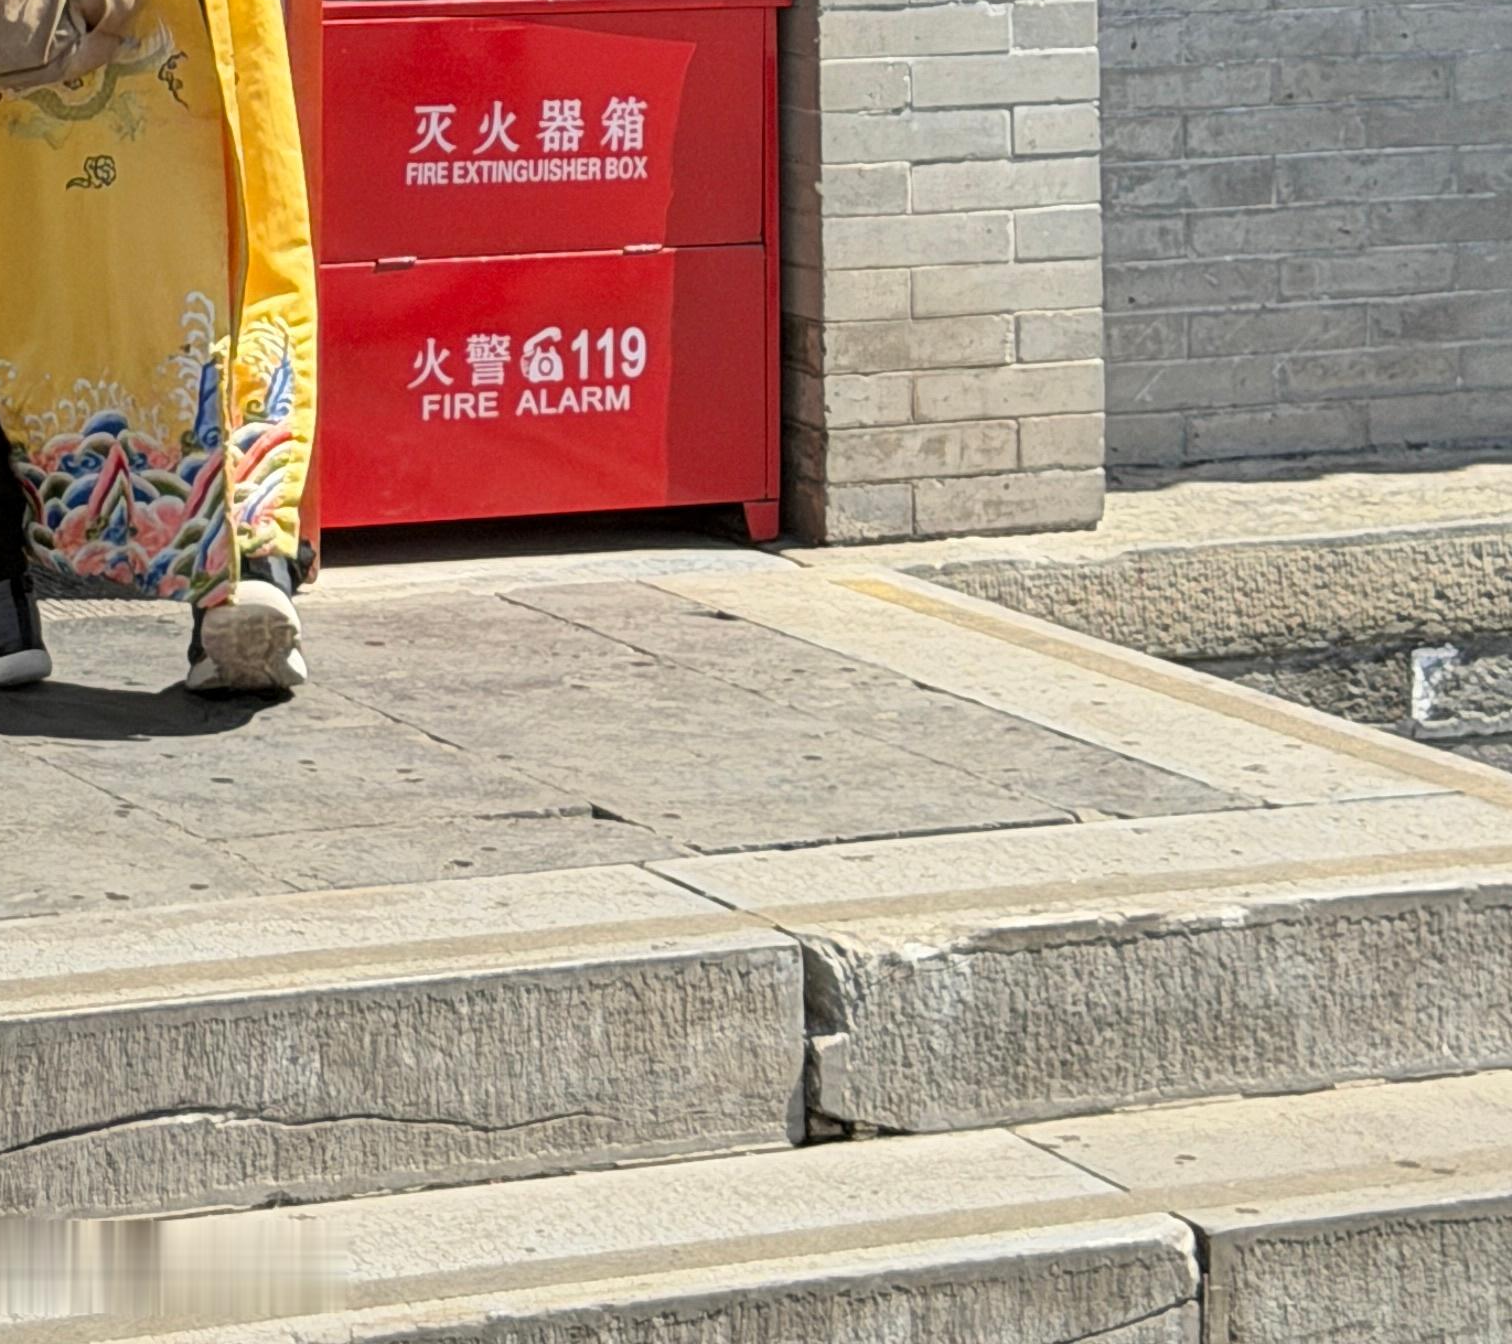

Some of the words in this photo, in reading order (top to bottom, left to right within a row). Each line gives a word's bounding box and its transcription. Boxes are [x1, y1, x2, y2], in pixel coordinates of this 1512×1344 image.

[408, 95, 649, 155] 灭火器箱
[405, 160, 449, 186] FIRE
[451, 157, 603, 185] EXTINGUISHER
[604, 155, 649, 181] BOX
[406, 332, 512, 390] 火警
[570, 325, 648, 380] 119
[421, 390, 500, 421] FIRE
[515, 384, 631, 416] ALARM
